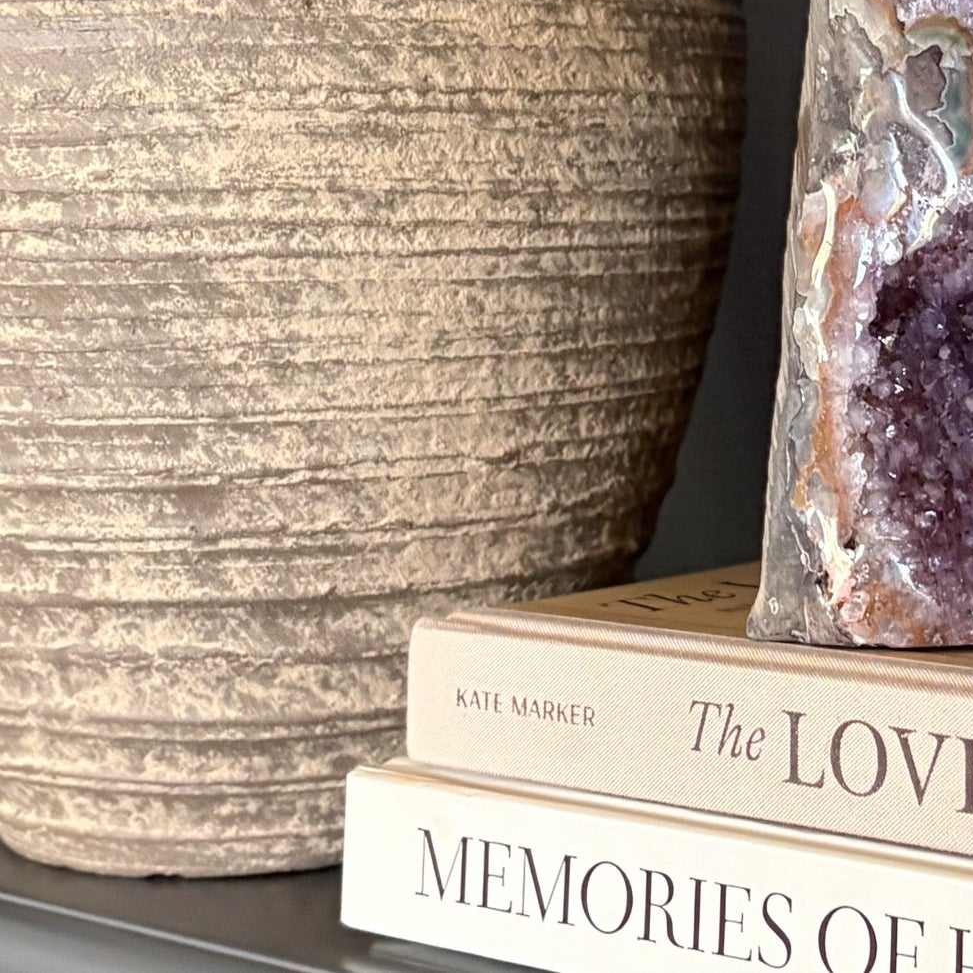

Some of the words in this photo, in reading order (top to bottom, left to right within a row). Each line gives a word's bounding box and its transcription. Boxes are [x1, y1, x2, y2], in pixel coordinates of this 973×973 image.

[599, 588, 736, 613] The
[456, 687, 503, 714] KATE
[511, 695, 596, 728] MARKER
[689, 700, 766, 761] The
[415, 828, 793, 969] MEMORIES
[818, 905, 925, 973] OF
